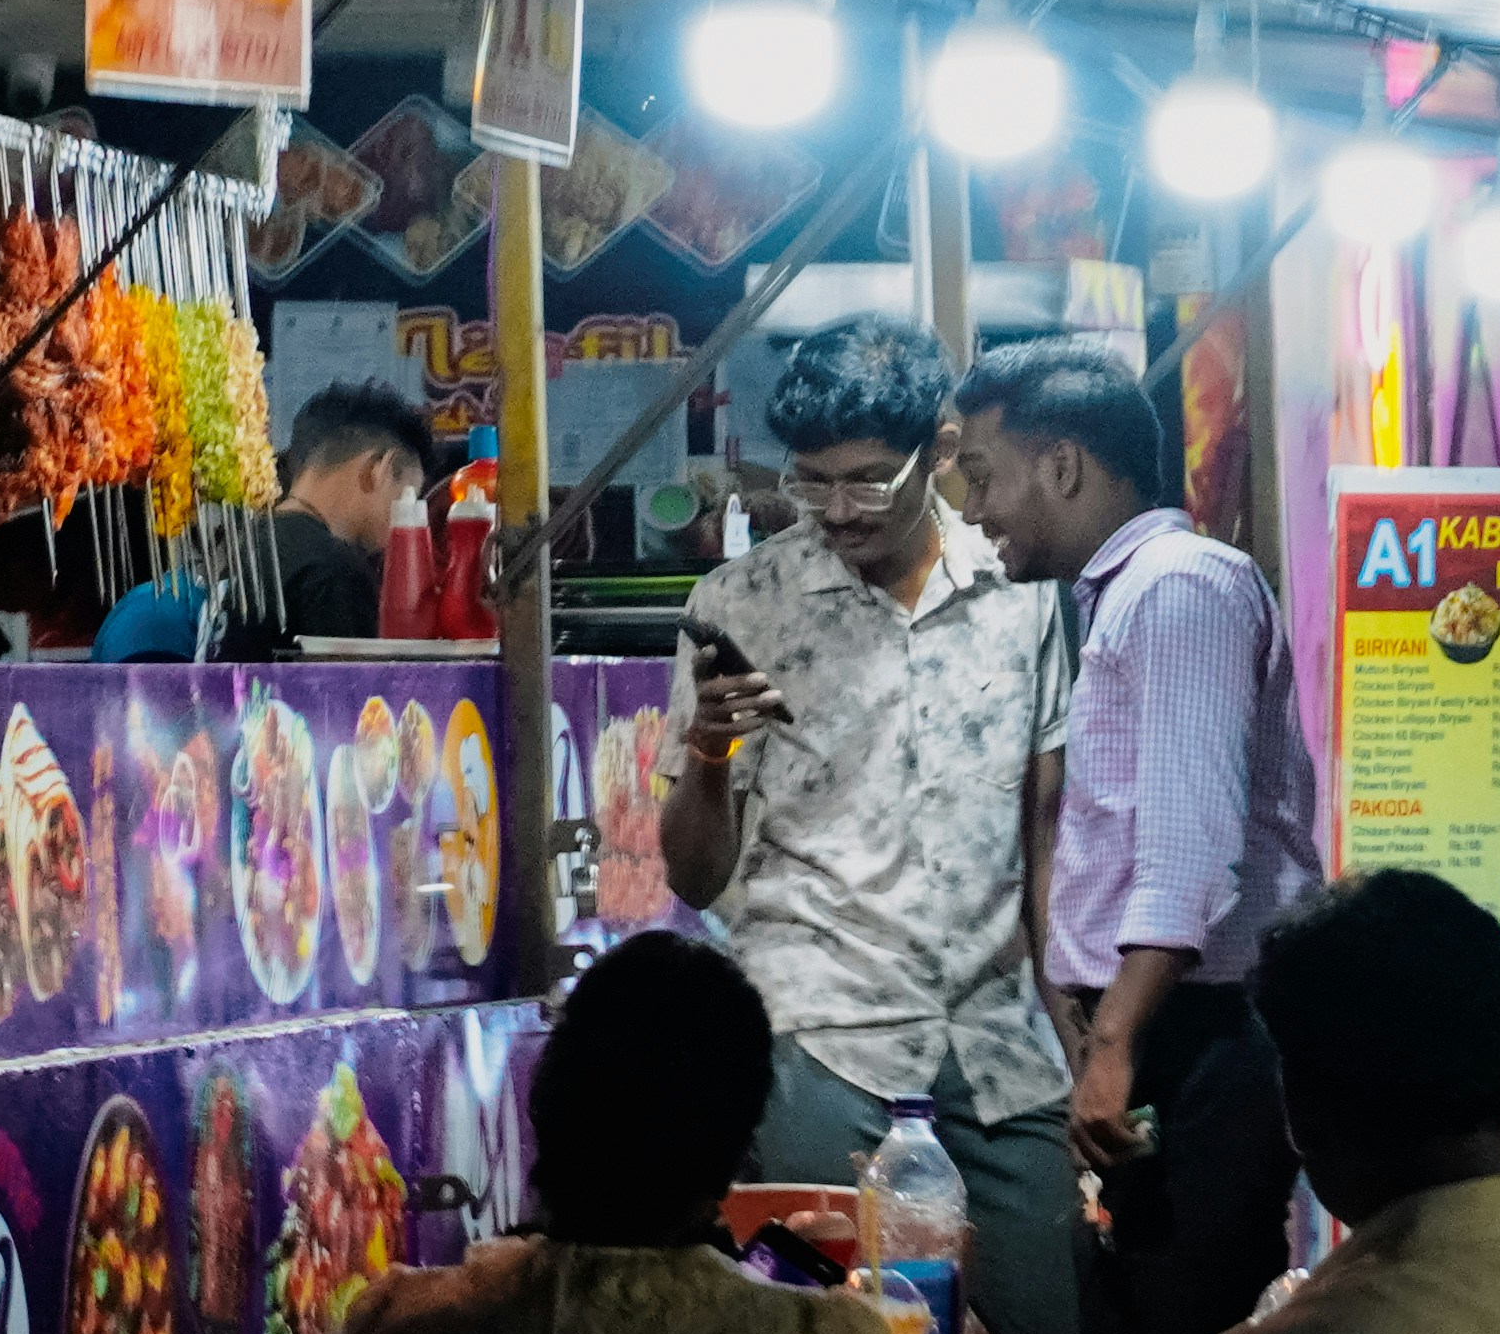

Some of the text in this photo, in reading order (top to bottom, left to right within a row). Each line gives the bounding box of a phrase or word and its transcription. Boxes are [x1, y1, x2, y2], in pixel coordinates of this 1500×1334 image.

[1357, 517, 1437, 588] A1
[1355, 638, 1428, 657] BIRIYANI
[1350, 799, 1423, 817] PAKODA
